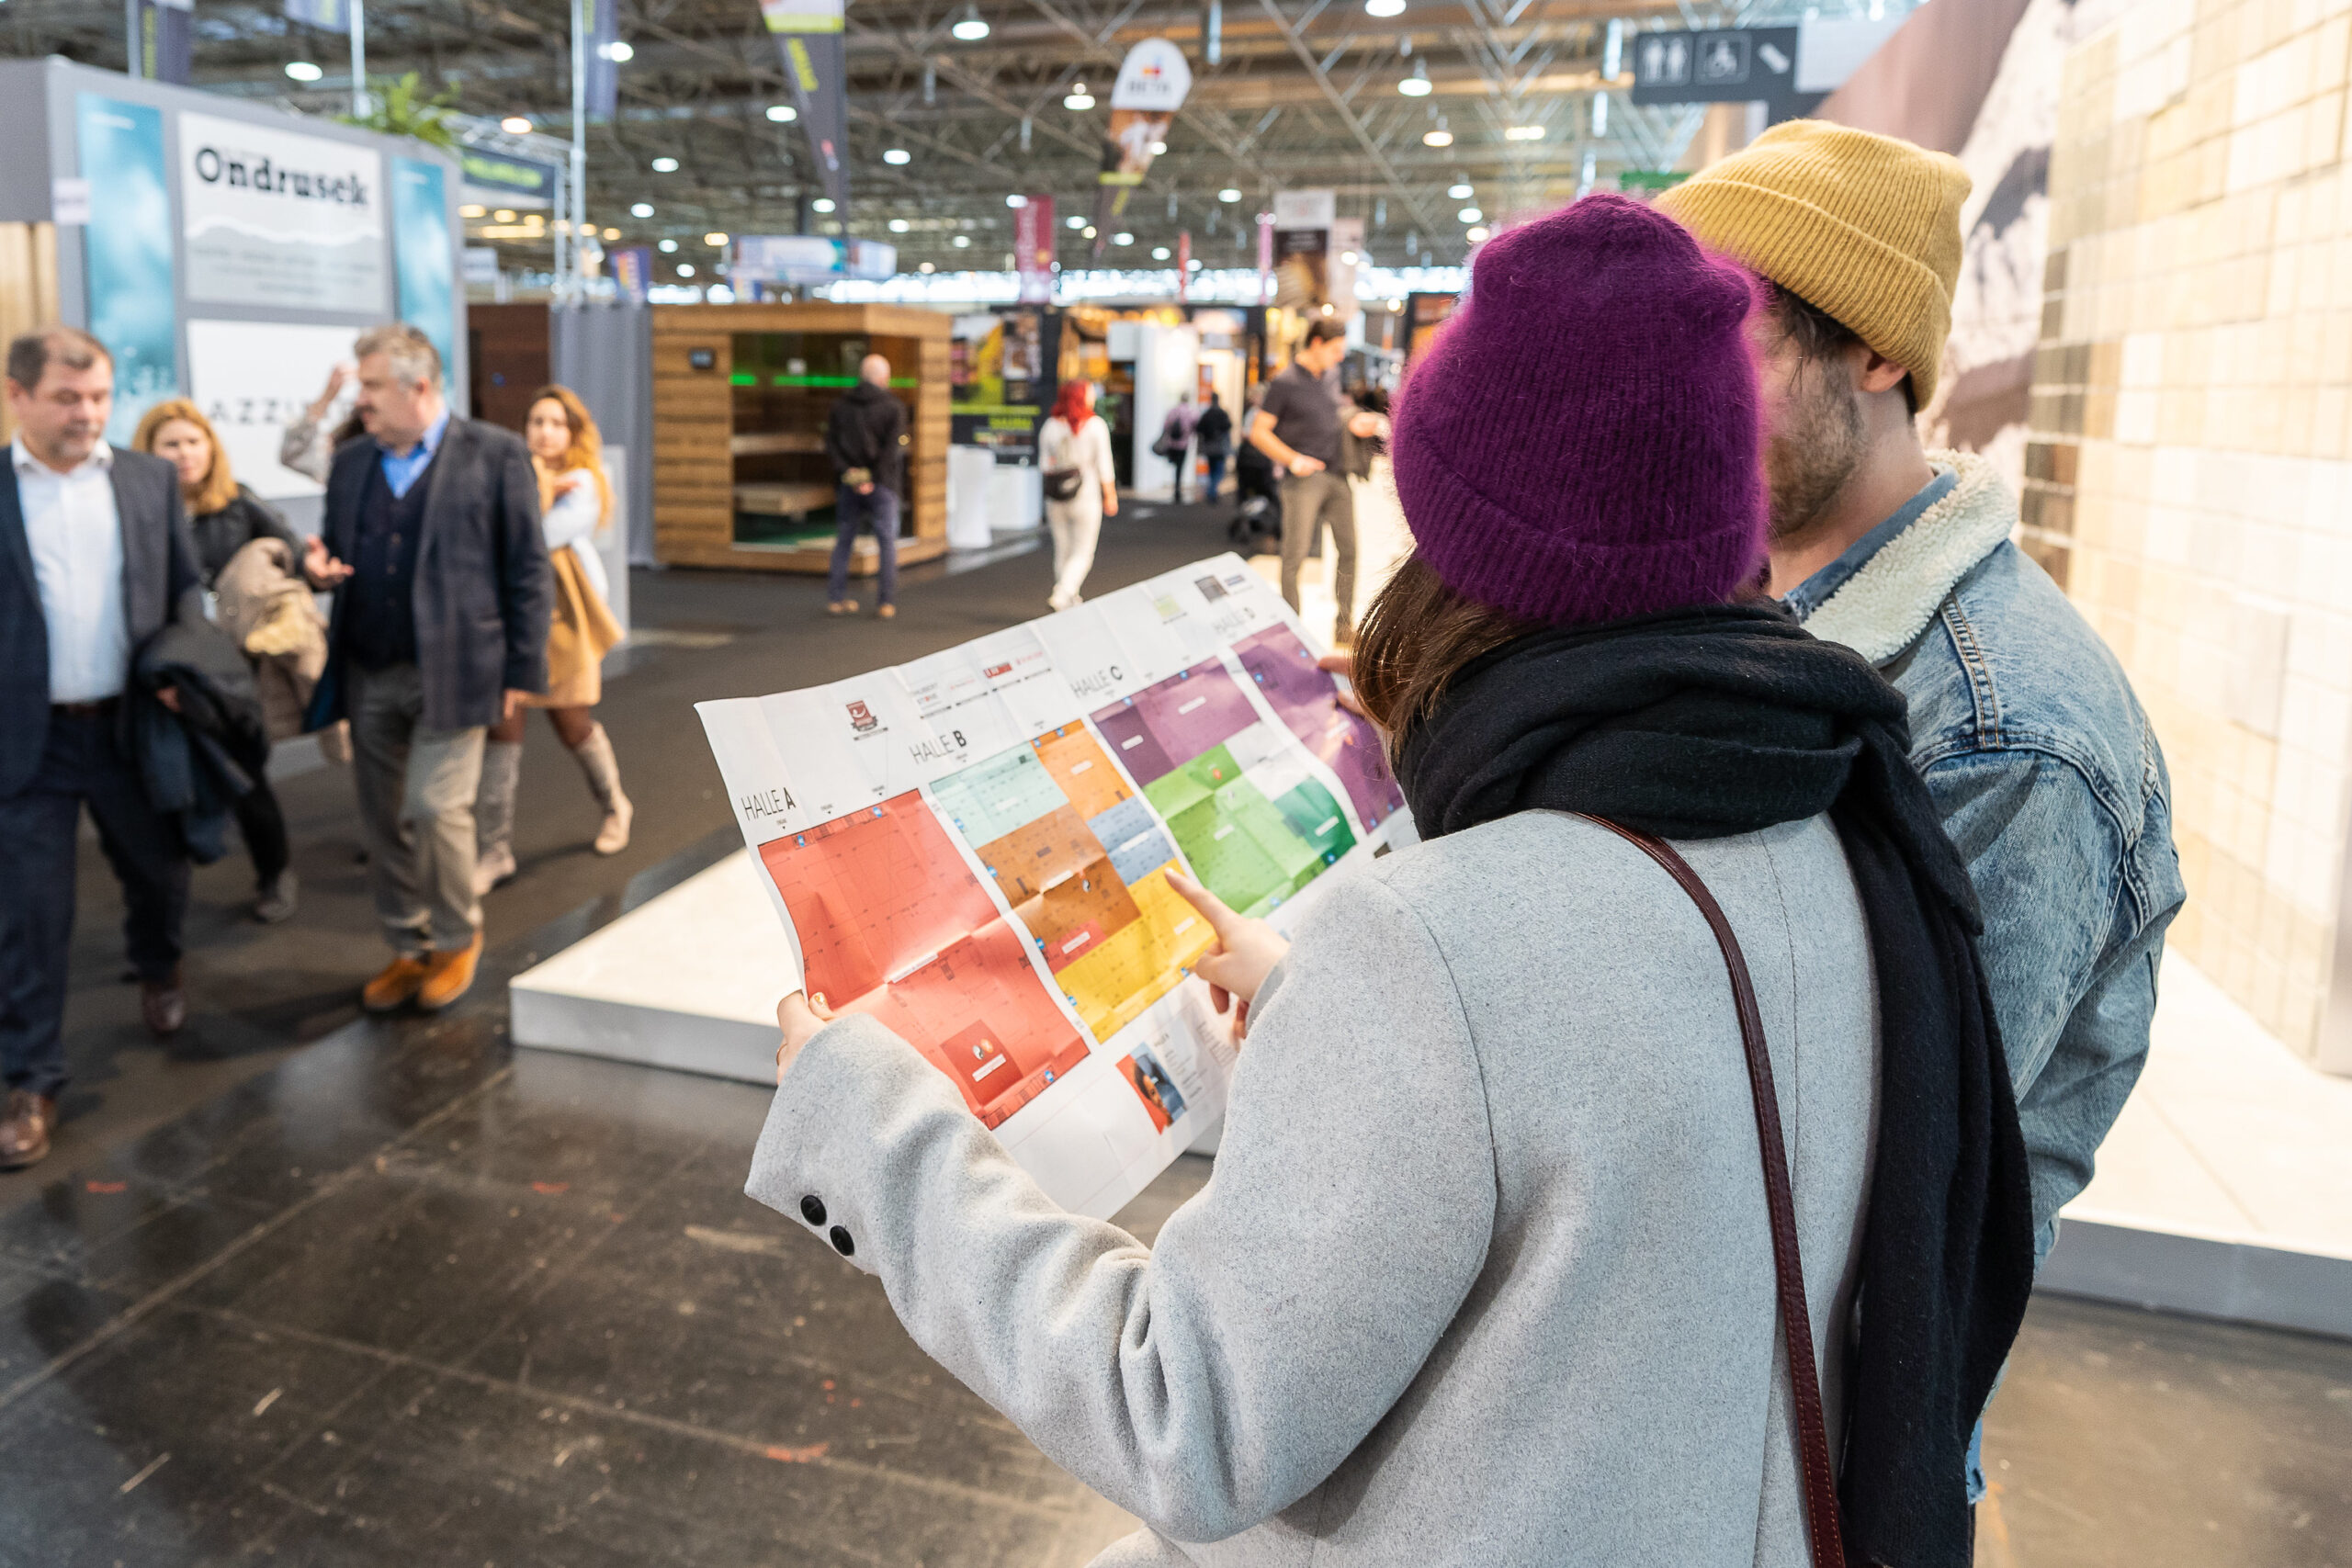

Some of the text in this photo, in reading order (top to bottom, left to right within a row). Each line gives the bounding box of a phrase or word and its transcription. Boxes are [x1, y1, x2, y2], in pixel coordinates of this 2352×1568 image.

[195, 147, 368, 205] Ondrusek
[1069, 670, 1111, 699] HALLE
[1110, 665, 1123, 681] C
[909, 734, 955, 765] HALLE
[952, 729, 967, 748] B
[741, 786, 797, 821] HALLE A
